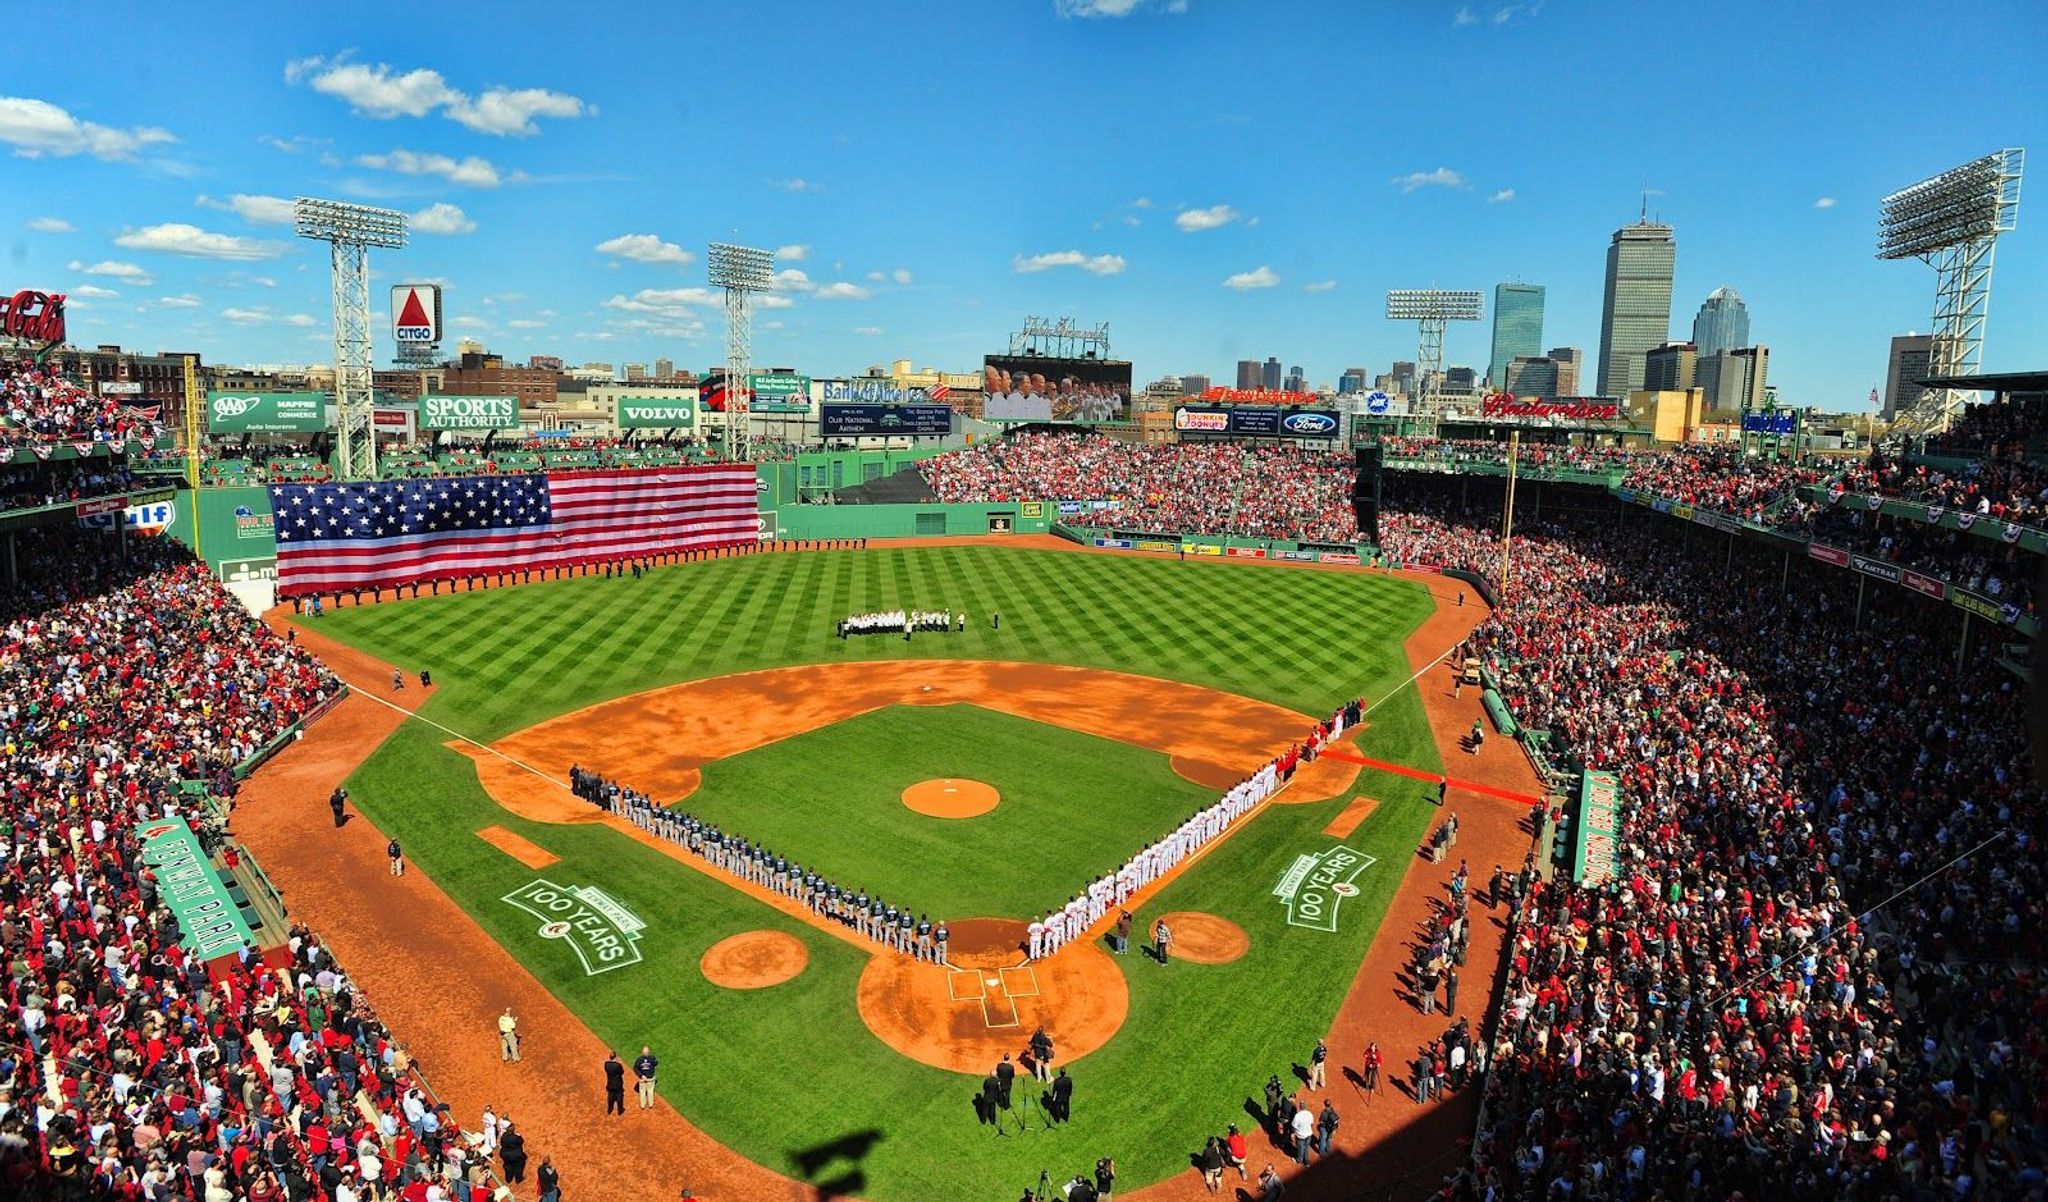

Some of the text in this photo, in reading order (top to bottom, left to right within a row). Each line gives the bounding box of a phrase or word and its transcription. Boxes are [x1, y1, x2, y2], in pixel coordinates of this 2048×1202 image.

[397, 327, 431, 339] CITGO
[824, 380, 858, 401] Bank
[426, 398, 513, 416] SPORTS
[623, 407, 691, 420] VOLVO
[1482, 392, 1617, 419] Budweiser
[1190, 420, 1224, 428] DONUTS
[1293, 417, 1325, 431] Ford
[1862, 563, 1898, 580] AMTRAK
[152, 838, 243, 954] FENWAY PARK
[1298, 853, 1357, 921] 100 YEARS
[524, 887, 625, 962] 100 YEARS
